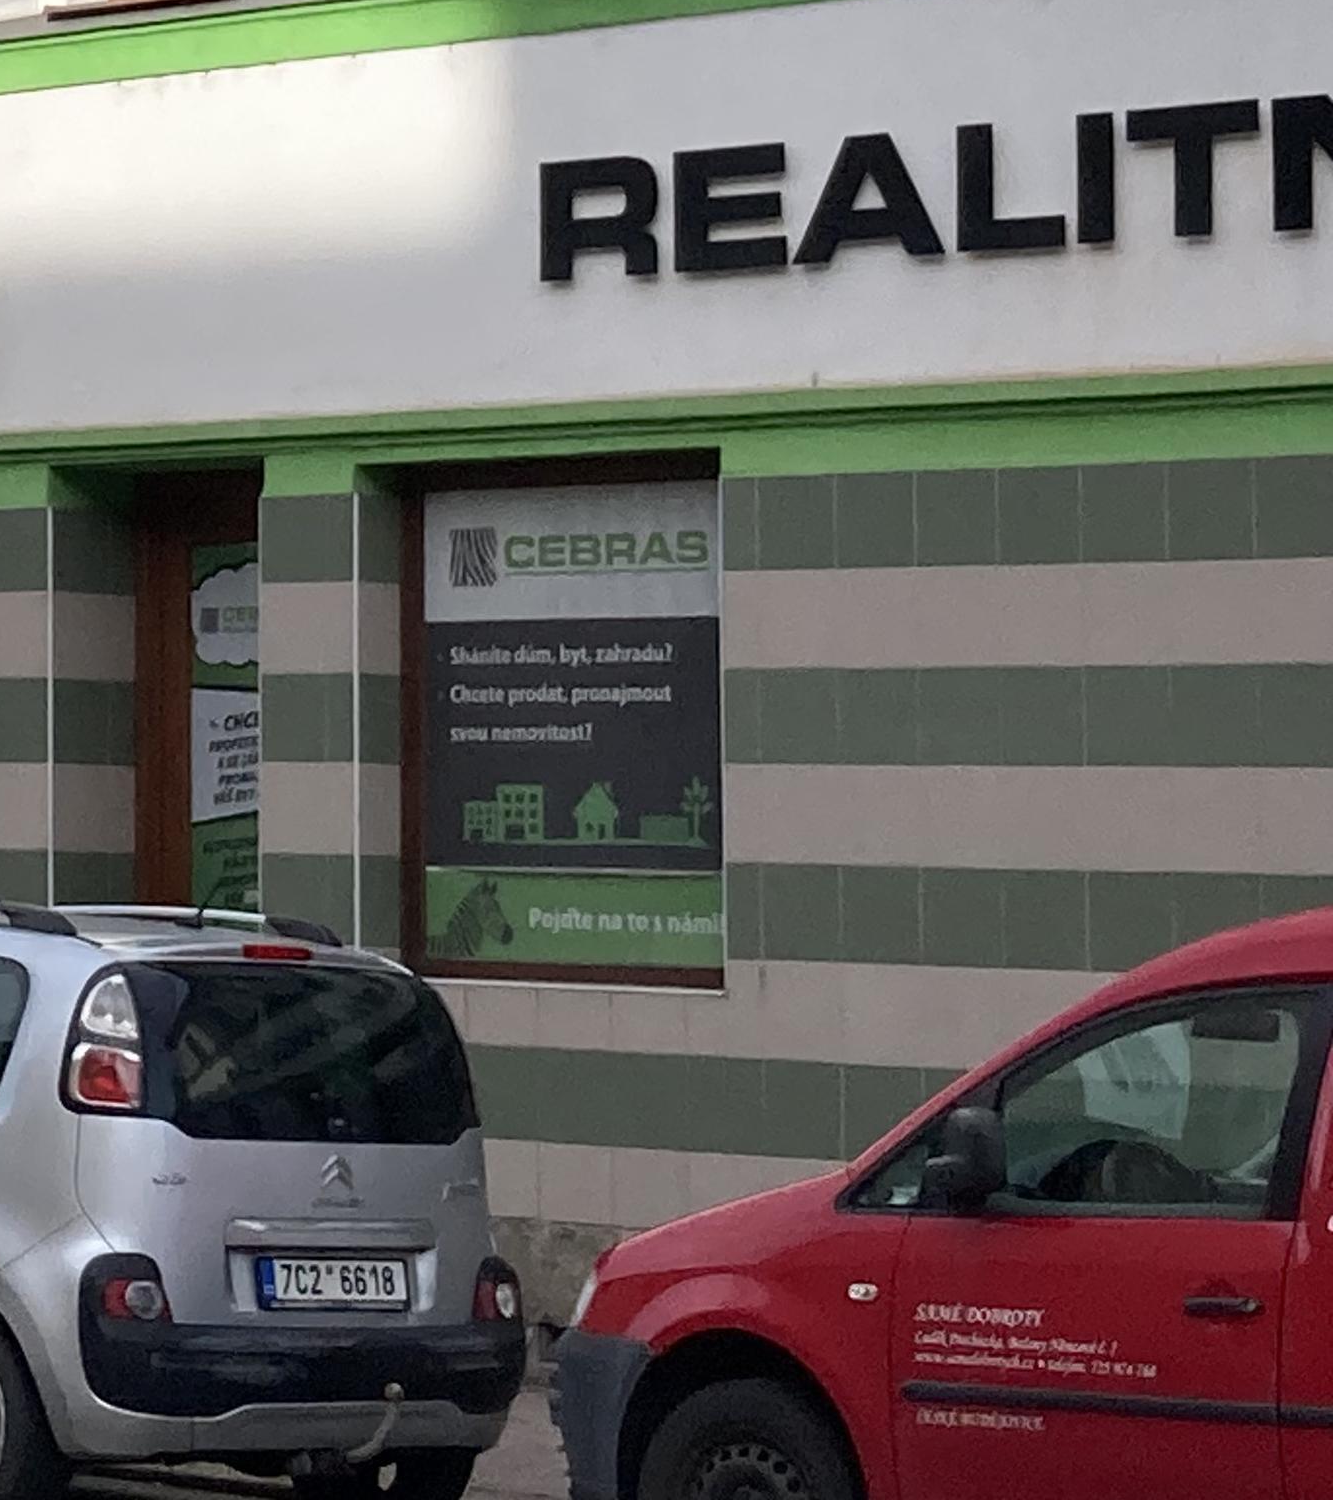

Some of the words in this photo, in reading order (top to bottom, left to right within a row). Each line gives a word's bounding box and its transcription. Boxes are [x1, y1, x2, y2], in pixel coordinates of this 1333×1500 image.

[504, 530, 709, 569] CEBRAS
[598, 912, 623, 932] na
[280, 1263, 324, 1295] 7C2
[339, 1263, 396, 1296] 6618
